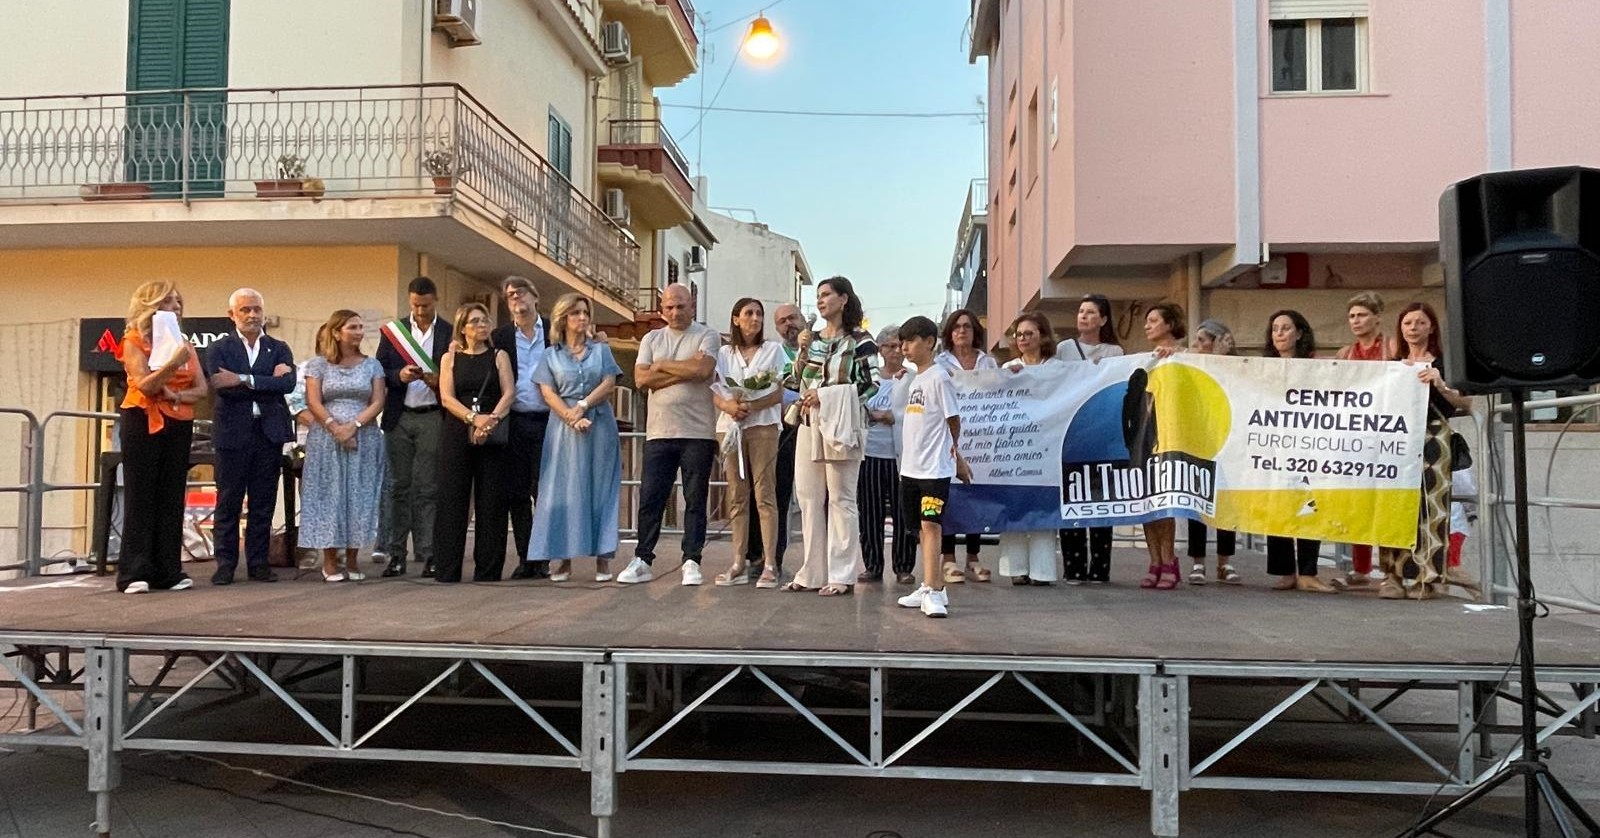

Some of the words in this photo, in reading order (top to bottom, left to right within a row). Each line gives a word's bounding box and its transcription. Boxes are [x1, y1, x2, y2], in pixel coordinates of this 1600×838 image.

[1006, 389, 1013, 398] a
[1285, 388, 1373, 408] CENTRO
[960, 404, 978, 412] non
[968, 412, 997, 423] dietro
[1000, 412, 1009, 421] di
[1248, 409, 1408, 434] ANTIVIOLENZA
[963, 425, 994, 437] esserti
[996, 423, 1006, 434] di
[961, 438, 973, 451] al
[975, 441, 992, 451] mio
[993, 437, 1024, 453] fianco
[1247, 432, 1297, 449] FURCI
[1300, 435, 1363, 453] SICULO
[1379, 440, 1408, 456] ME
[993, 452, 1010, 462] mio
[1251, 455, 1282, 471] Tel.
[1286, 457, 1318, 473] 320
[1321, 460, 1398, 479] 6329120
[1068, 464, 1092, 502] al
[1064, 495, 1214, 517] ASSOCIAZIONE
